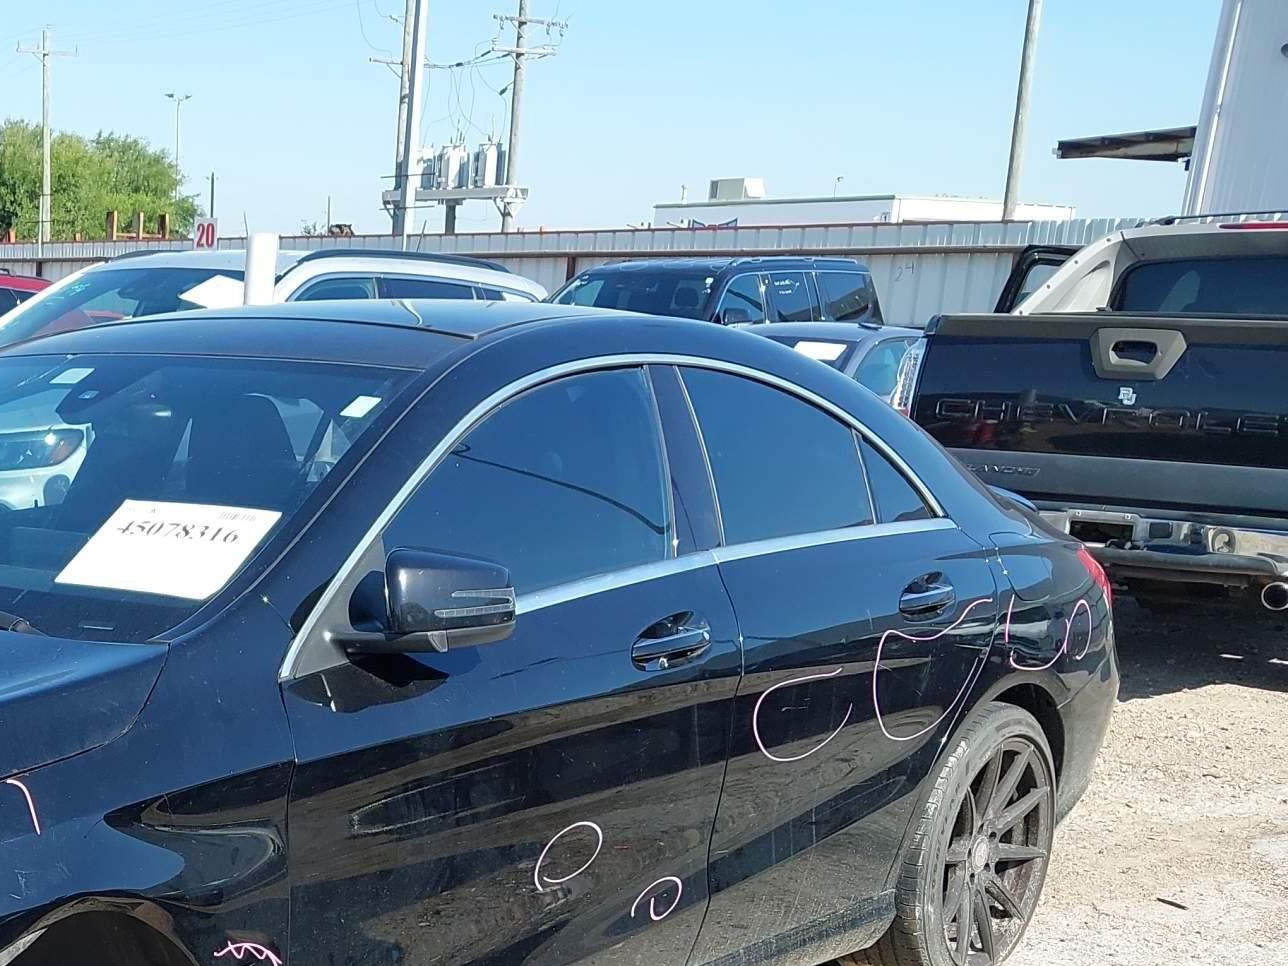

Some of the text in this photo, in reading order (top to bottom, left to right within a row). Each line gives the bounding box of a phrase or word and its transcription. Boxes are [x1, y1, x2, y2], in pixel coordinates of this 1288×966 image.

[196, 222, 215, 249] 20
[935, 398, 1288, 435] CHEVROLE
[116, 520, 240, 544] 45078316
